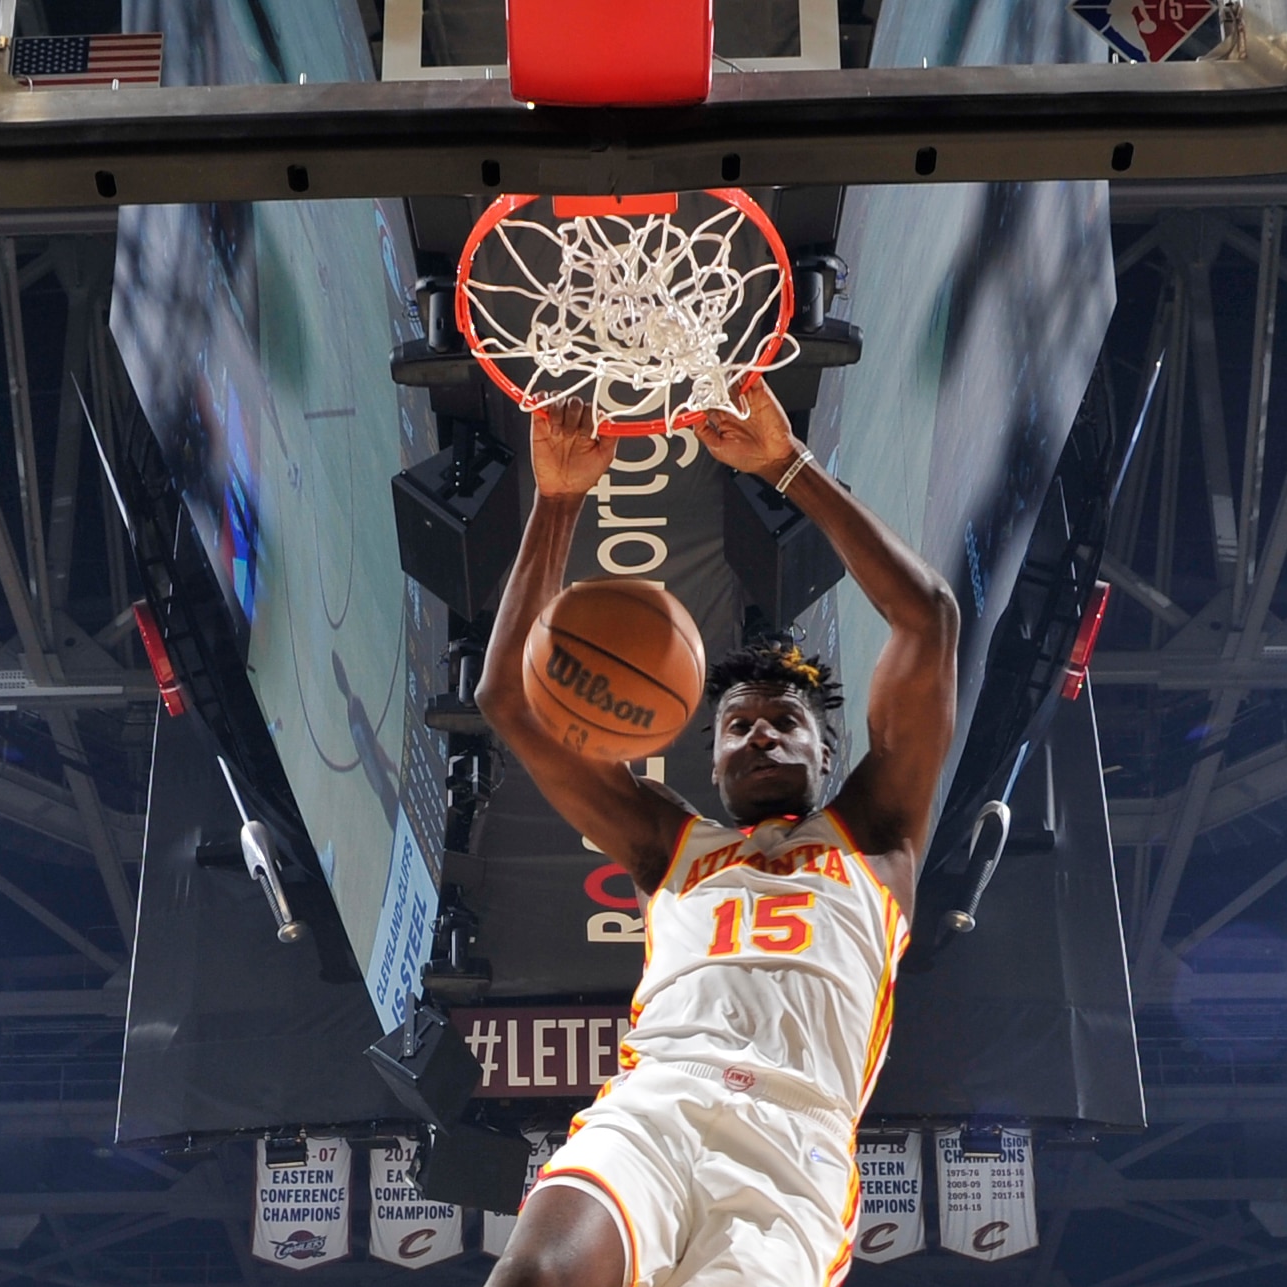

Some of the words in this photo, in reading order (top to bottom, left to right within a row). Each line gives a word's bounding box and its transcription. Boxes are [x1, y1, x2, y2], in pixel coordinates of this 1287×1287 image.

[546, 644, 655, 729] Wilson
[678, 844, 851, 899] ATLANTA
[402, 894, 428, 992] STEEL
[707, 893, 815, 957] 15
[464, 1017, 632, 1088] #LETE
[260, 1187, 345, 1204] CONFERENCE
[272, 1169, 334, 1185] EASTERN
[263, 1206, 341, 1222] CHAMPIONS
[377, 1203, 455, 1221] CHAMPIONS
